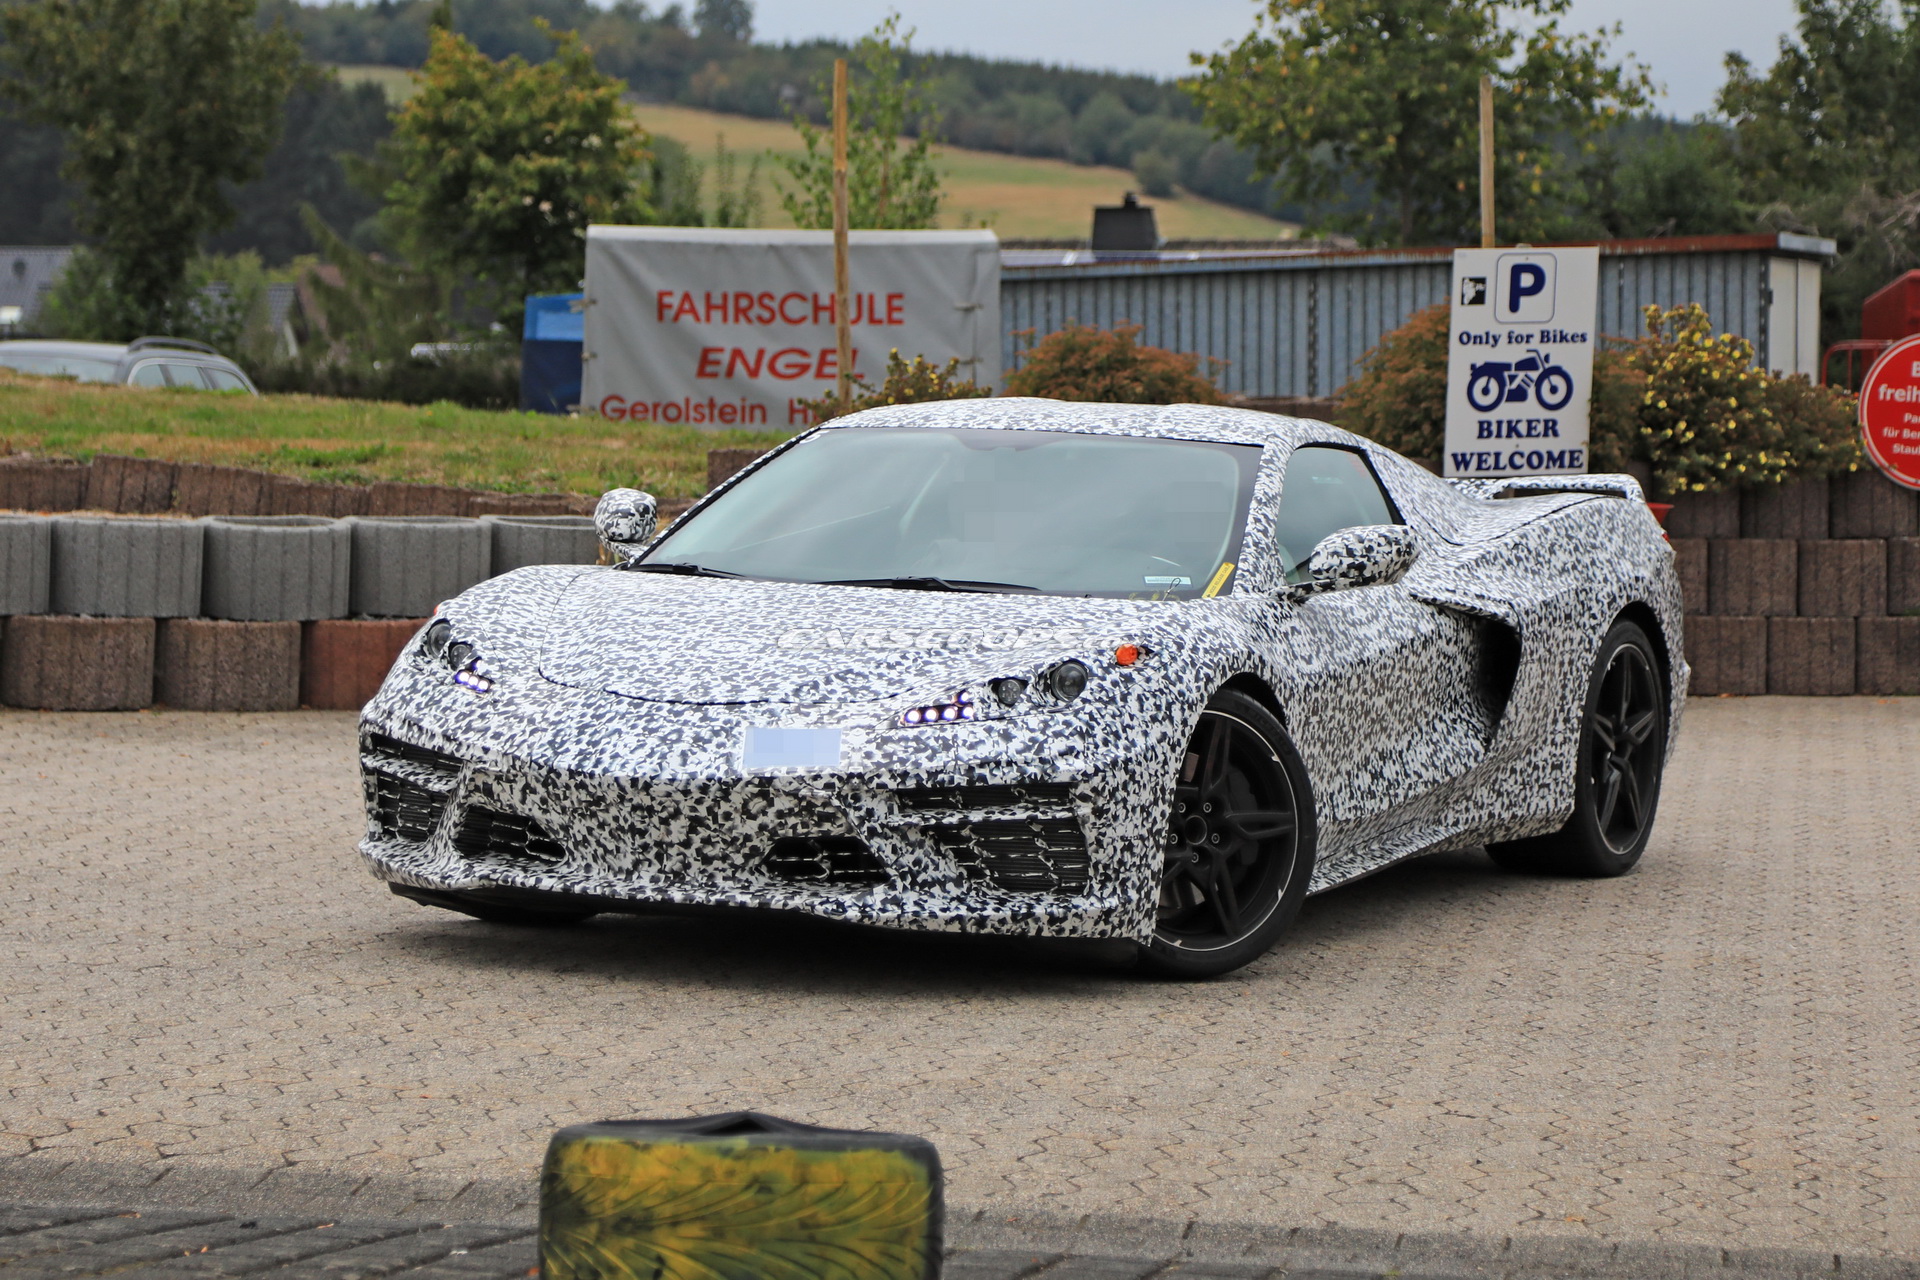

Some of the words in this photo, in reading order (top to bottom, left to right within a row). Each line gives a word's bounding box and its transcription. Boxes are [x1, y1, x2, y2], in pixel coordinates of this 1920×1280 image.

[1509, 263, 1546, 313] P
[656, 290, 905, 327] FAHRSCHULE
[1458, 330, 1501, 348] Only
[1507, 330, 1534, 345] for
[1539, 329, 1588, 344] Bikes
[696, 346, 866, 380] ENGEL
[600, 394, 767, 424] Gerolstein
[1476, 418, 1560, 439] BIKER
[1883, 426, 1899, 438] für
[1451, 449, 1584, 472] WELCOME
